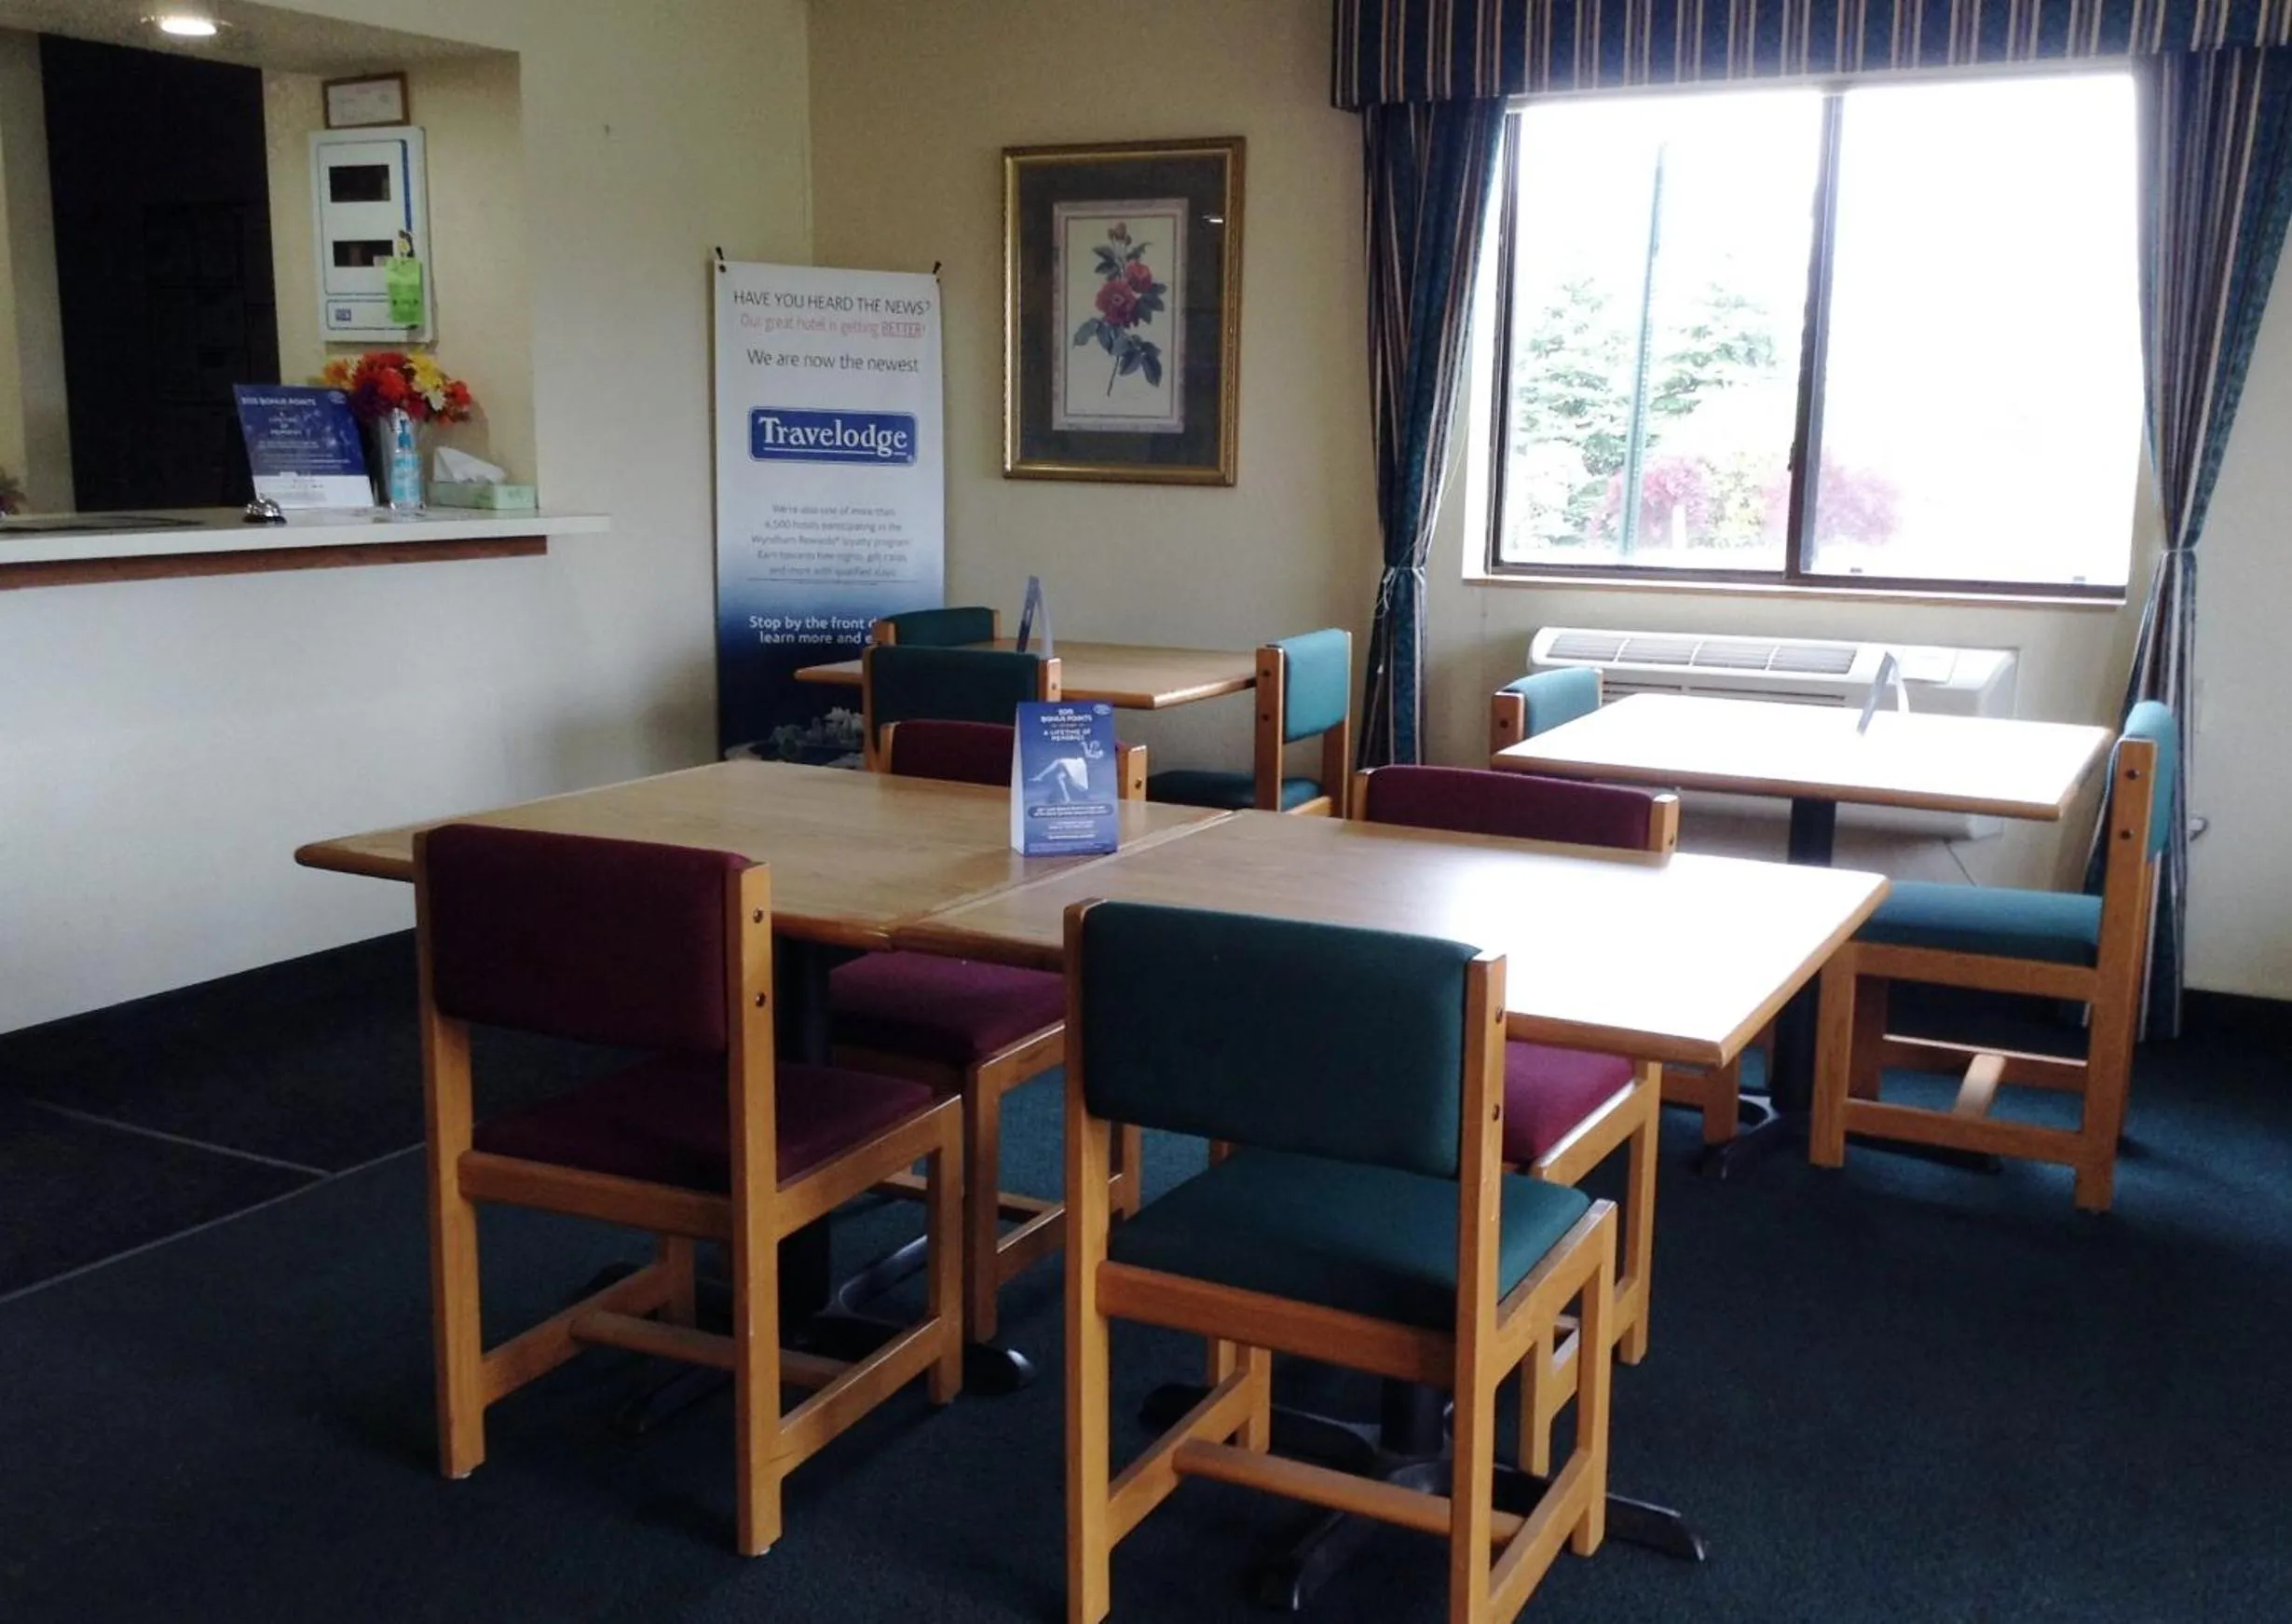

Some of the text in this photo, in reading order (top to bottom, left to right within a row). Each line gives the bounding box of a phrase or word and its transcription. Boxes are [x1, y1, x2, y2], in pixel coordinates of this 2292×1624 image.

[733, 291, 931, 316] HAVE YOU HEARD THE NEWS?
[741, 312, 760, 328] Our
[764, 315, 794, 333] great
[746, 348, 919, 373] We are now the newest
[757, 416, 908, 457] Travelodge
[749, 615, 782, 631] Stop
[784, 616, 802, 633] by
[805, 617, 828, 630] the
[831, 616, 865, 630] front
[759, 631, 794, 644] learn
[798, 634, 833, 644] more
[837, 632, 862, 644] and
